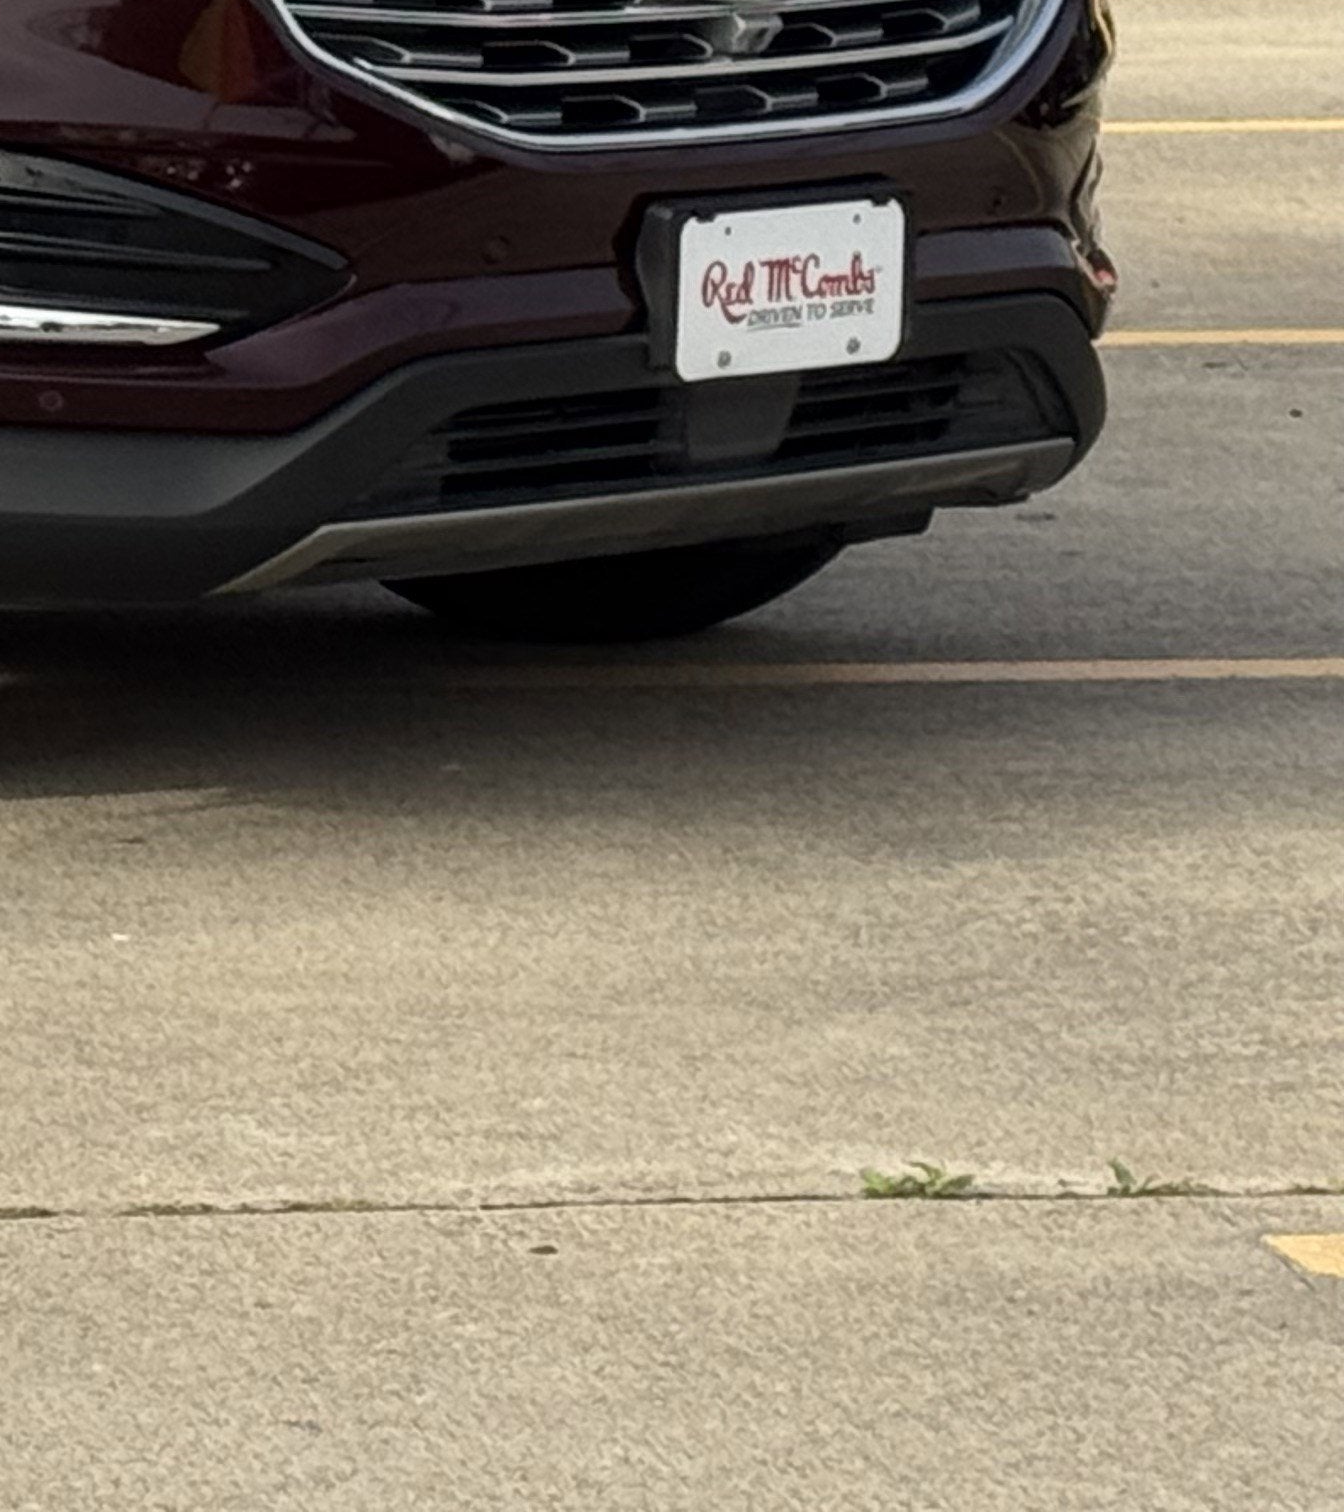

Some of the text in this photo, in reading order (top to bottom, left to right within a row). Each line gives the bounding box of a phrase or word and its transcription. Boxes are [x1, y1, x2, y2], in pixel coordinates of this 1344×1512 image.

[702, 251, 875, 324] Red McCombs
[747, 297, 875, 326] DRIVEN TO SERVE
